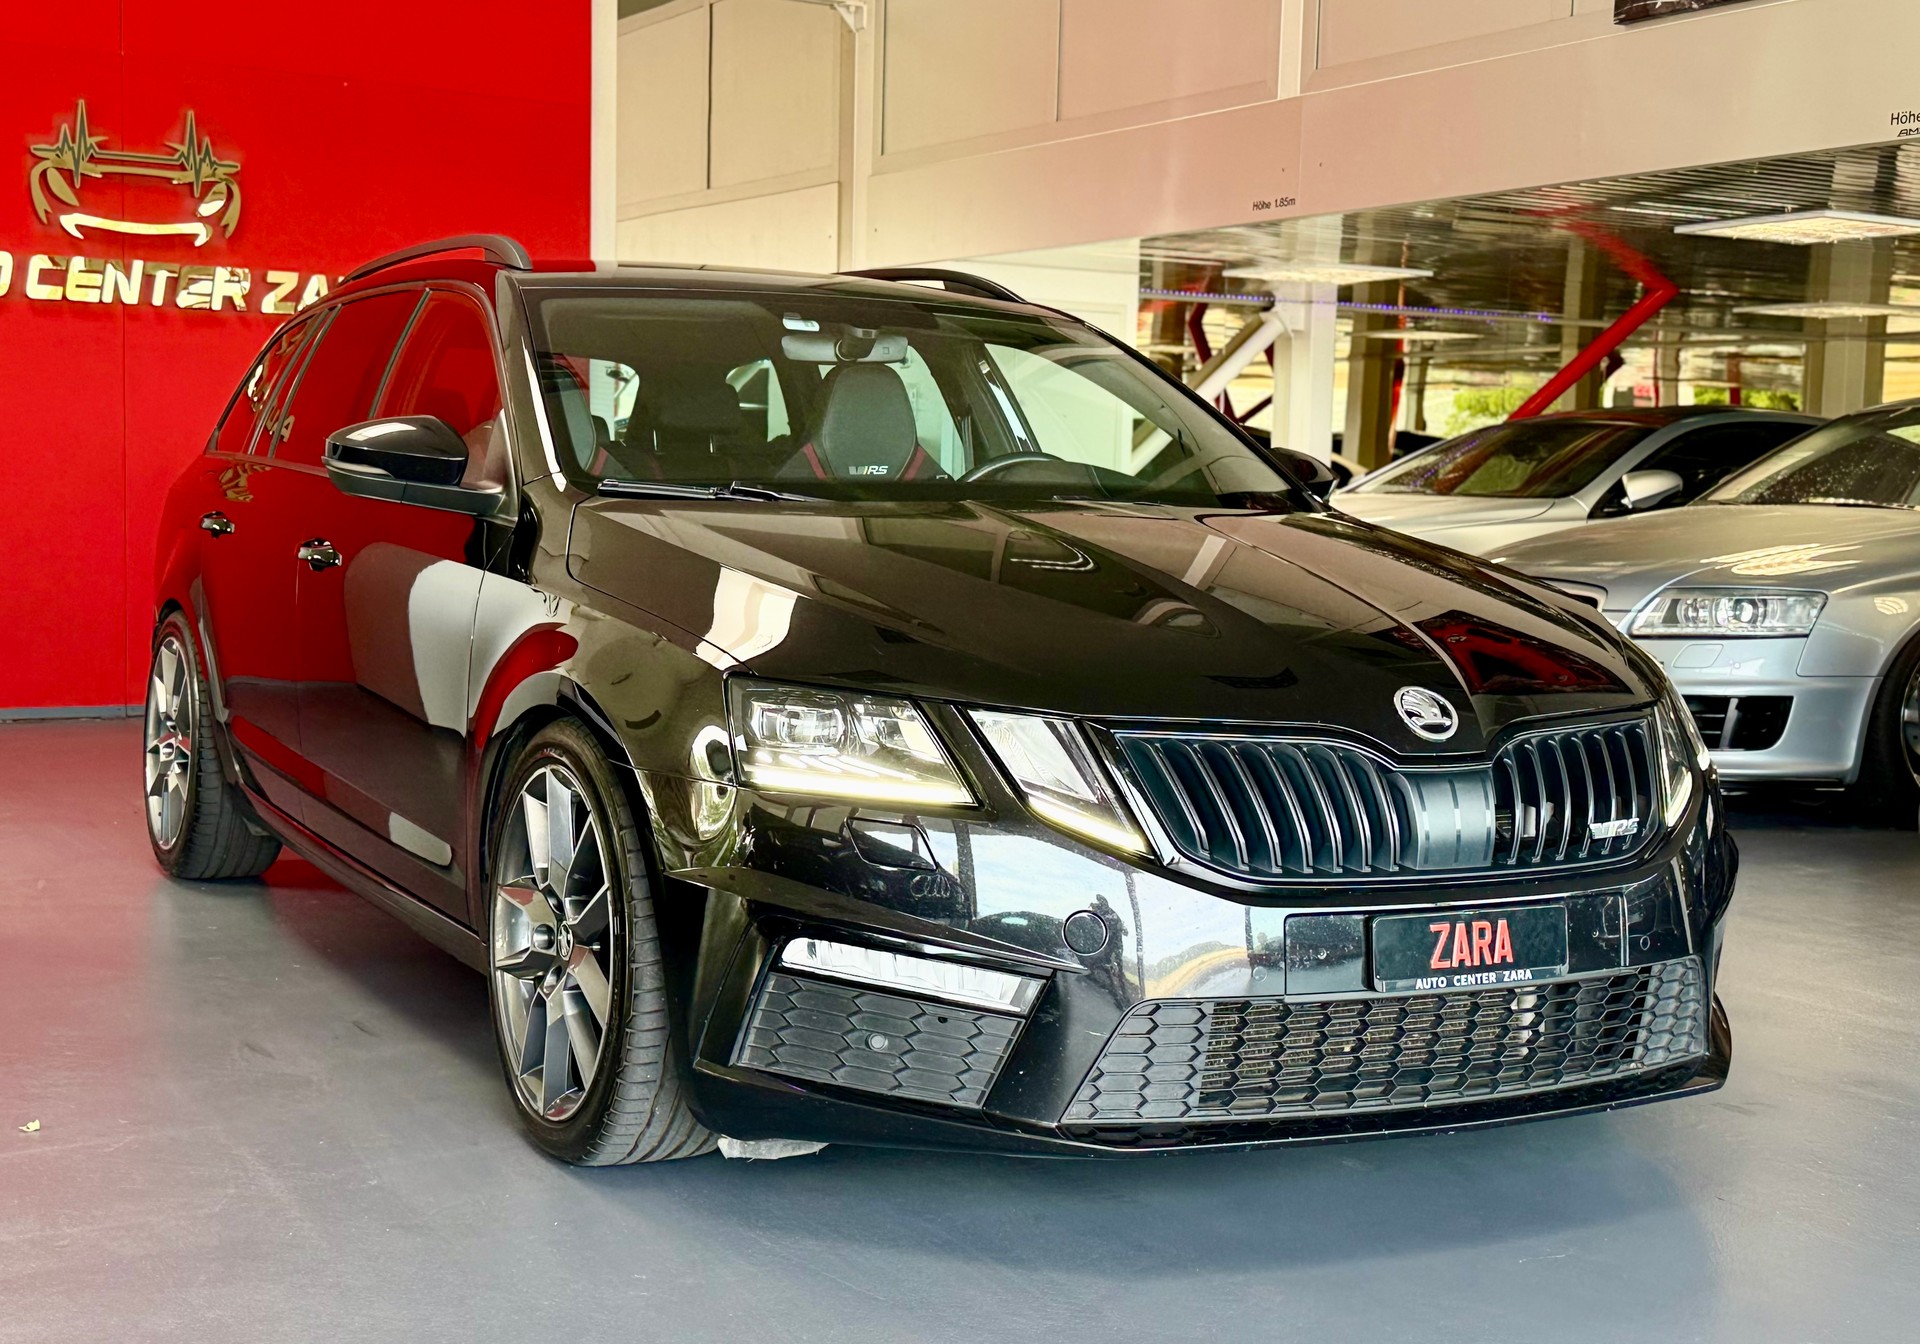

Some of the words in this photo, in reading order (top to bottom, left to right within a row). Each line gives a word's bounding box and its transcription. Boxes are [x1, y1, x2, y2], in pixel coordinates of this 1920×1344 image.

[1897, 127, 1920, 137] AM
[1252, 200, 1271, 211] Höhe
[25, 253, 250, 312] CENTER
[261, 270, 345, 315] ZA
[1429, 919, 1514, 969] ZARA
[1415, 976, 1447, 990] AUTO
[1453, 972, 1497, 987] CENTER
[1503, 968, 1533, 982] ZARA
